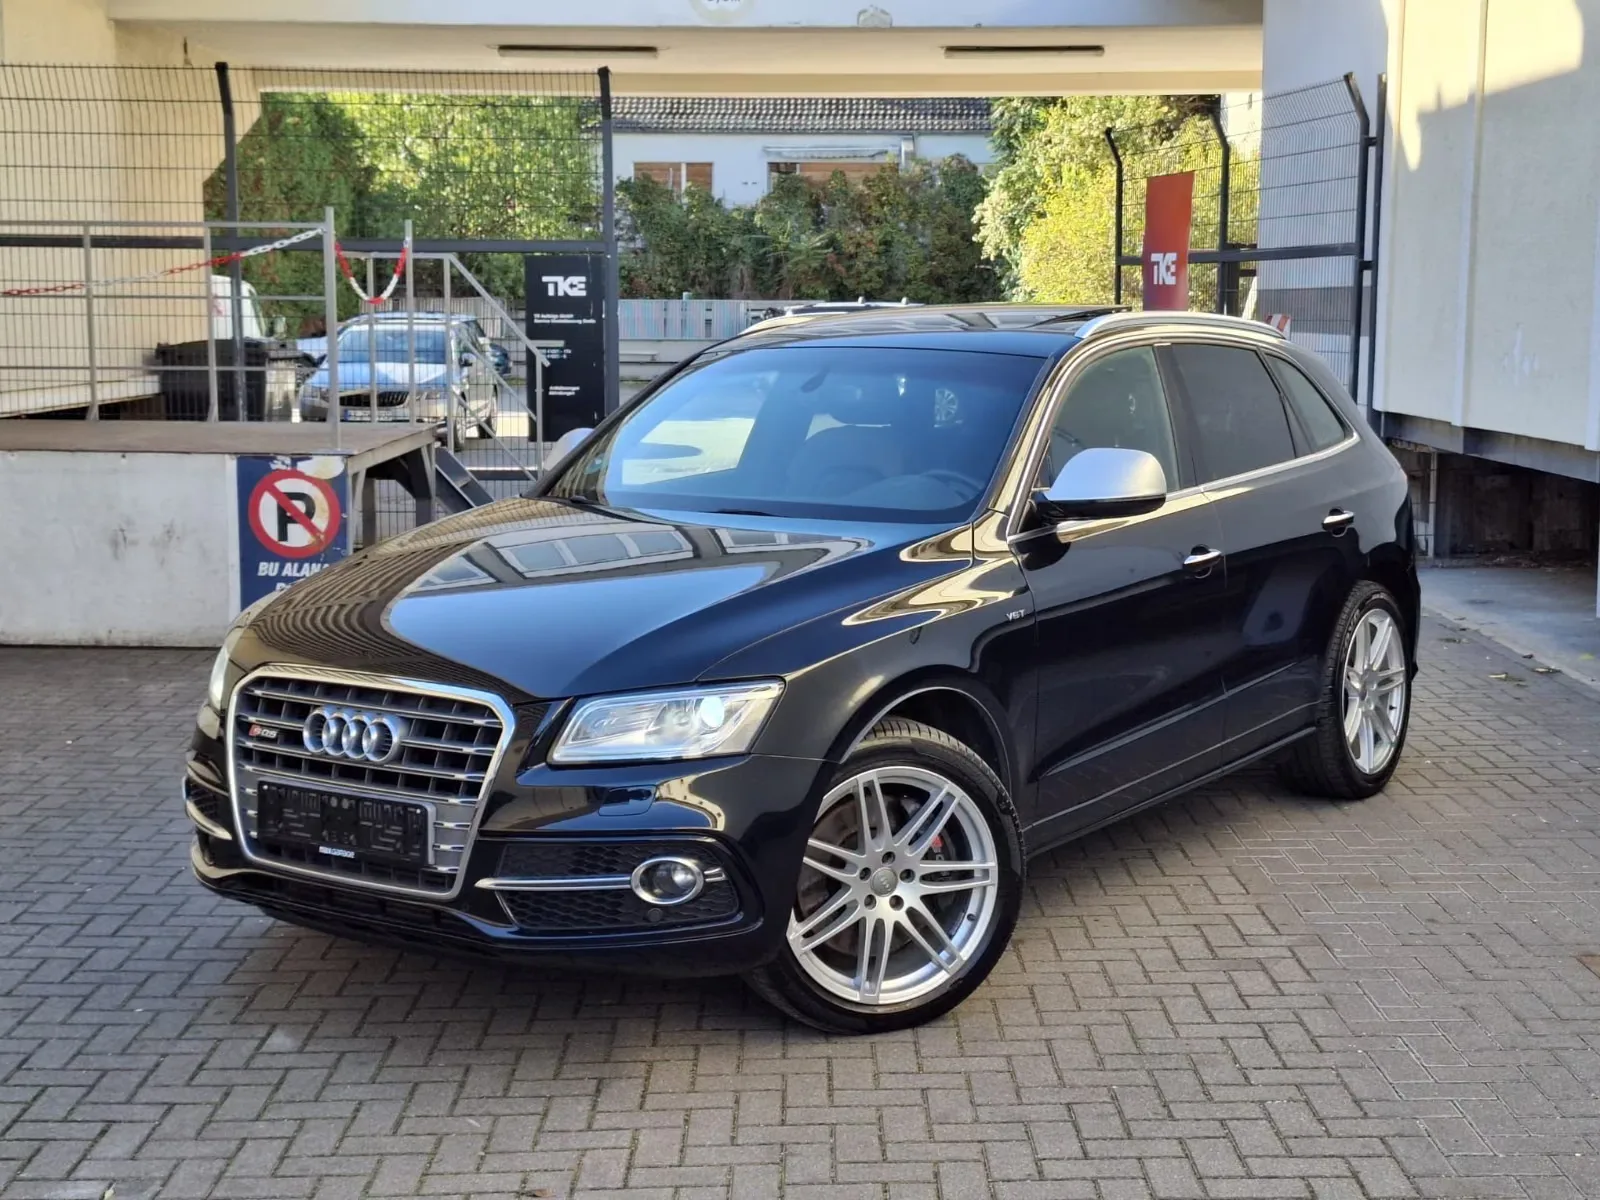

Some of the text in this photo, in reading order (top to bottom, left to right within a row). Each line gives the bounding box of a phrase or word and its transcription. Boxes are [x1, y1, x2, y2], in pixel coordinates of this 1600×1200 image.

[1150, 252, 1177, 285] TKE
[541, 275, 587, 297] TKE
[257, 562, 329, 577] BU ALAN
